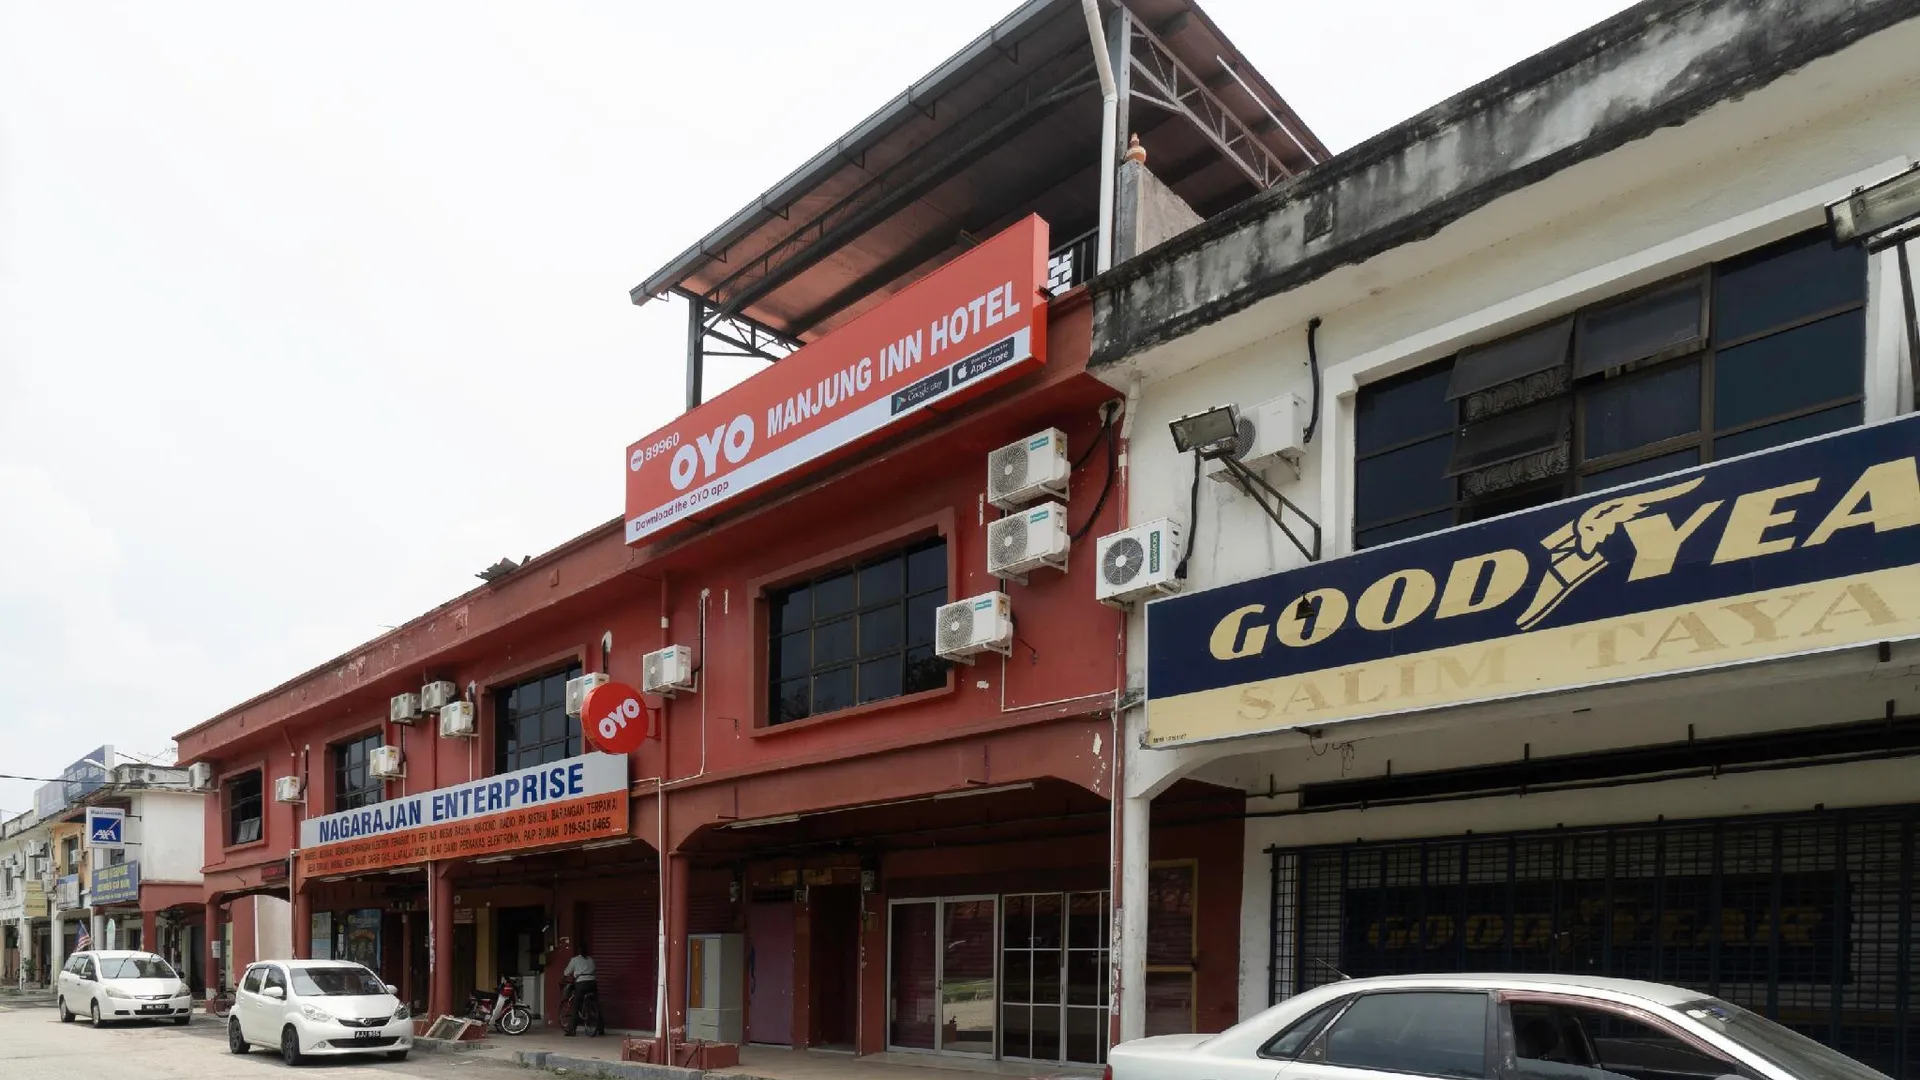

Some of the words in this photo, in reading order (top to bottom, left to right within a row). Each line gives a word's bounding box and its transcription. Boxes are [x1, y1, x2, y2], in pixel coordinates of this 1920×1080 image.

[766, 358, 871, 439] MANJUNG
[879, 328, 922, 382] INN
[929, 280, 1020, 353] HOTEL
[970, 362, 987, 375] App
[987, 350, 1009, 366] Store
[645, 432, 680, 461] 89960
[669, 413, 755, 491] OYO
[635, 505, 674, 532] Download
[675, 500, 687, 512] the
[690, 489, 709, 506] OYO
[711, 481, 729, 496] app
[1237, 644, 1509, 720] SALIM
[598, 698, 640, 739] OYO
[319, 799, 421, 843] NAGARAJAN
[432, 763, 584, 825] ENTERPRISE
[551, 803, 584, 820] BARANGAN
[586, 797, 618, 814] TERPAKAI
[92, 829, 117, 840] AXA
[523, 828, 536, 842] PAIP
[538, 824, 559, 840] RUMAH
[563, 819, 591, 836] 019-543
[592, 816, 610, 832] 0465
